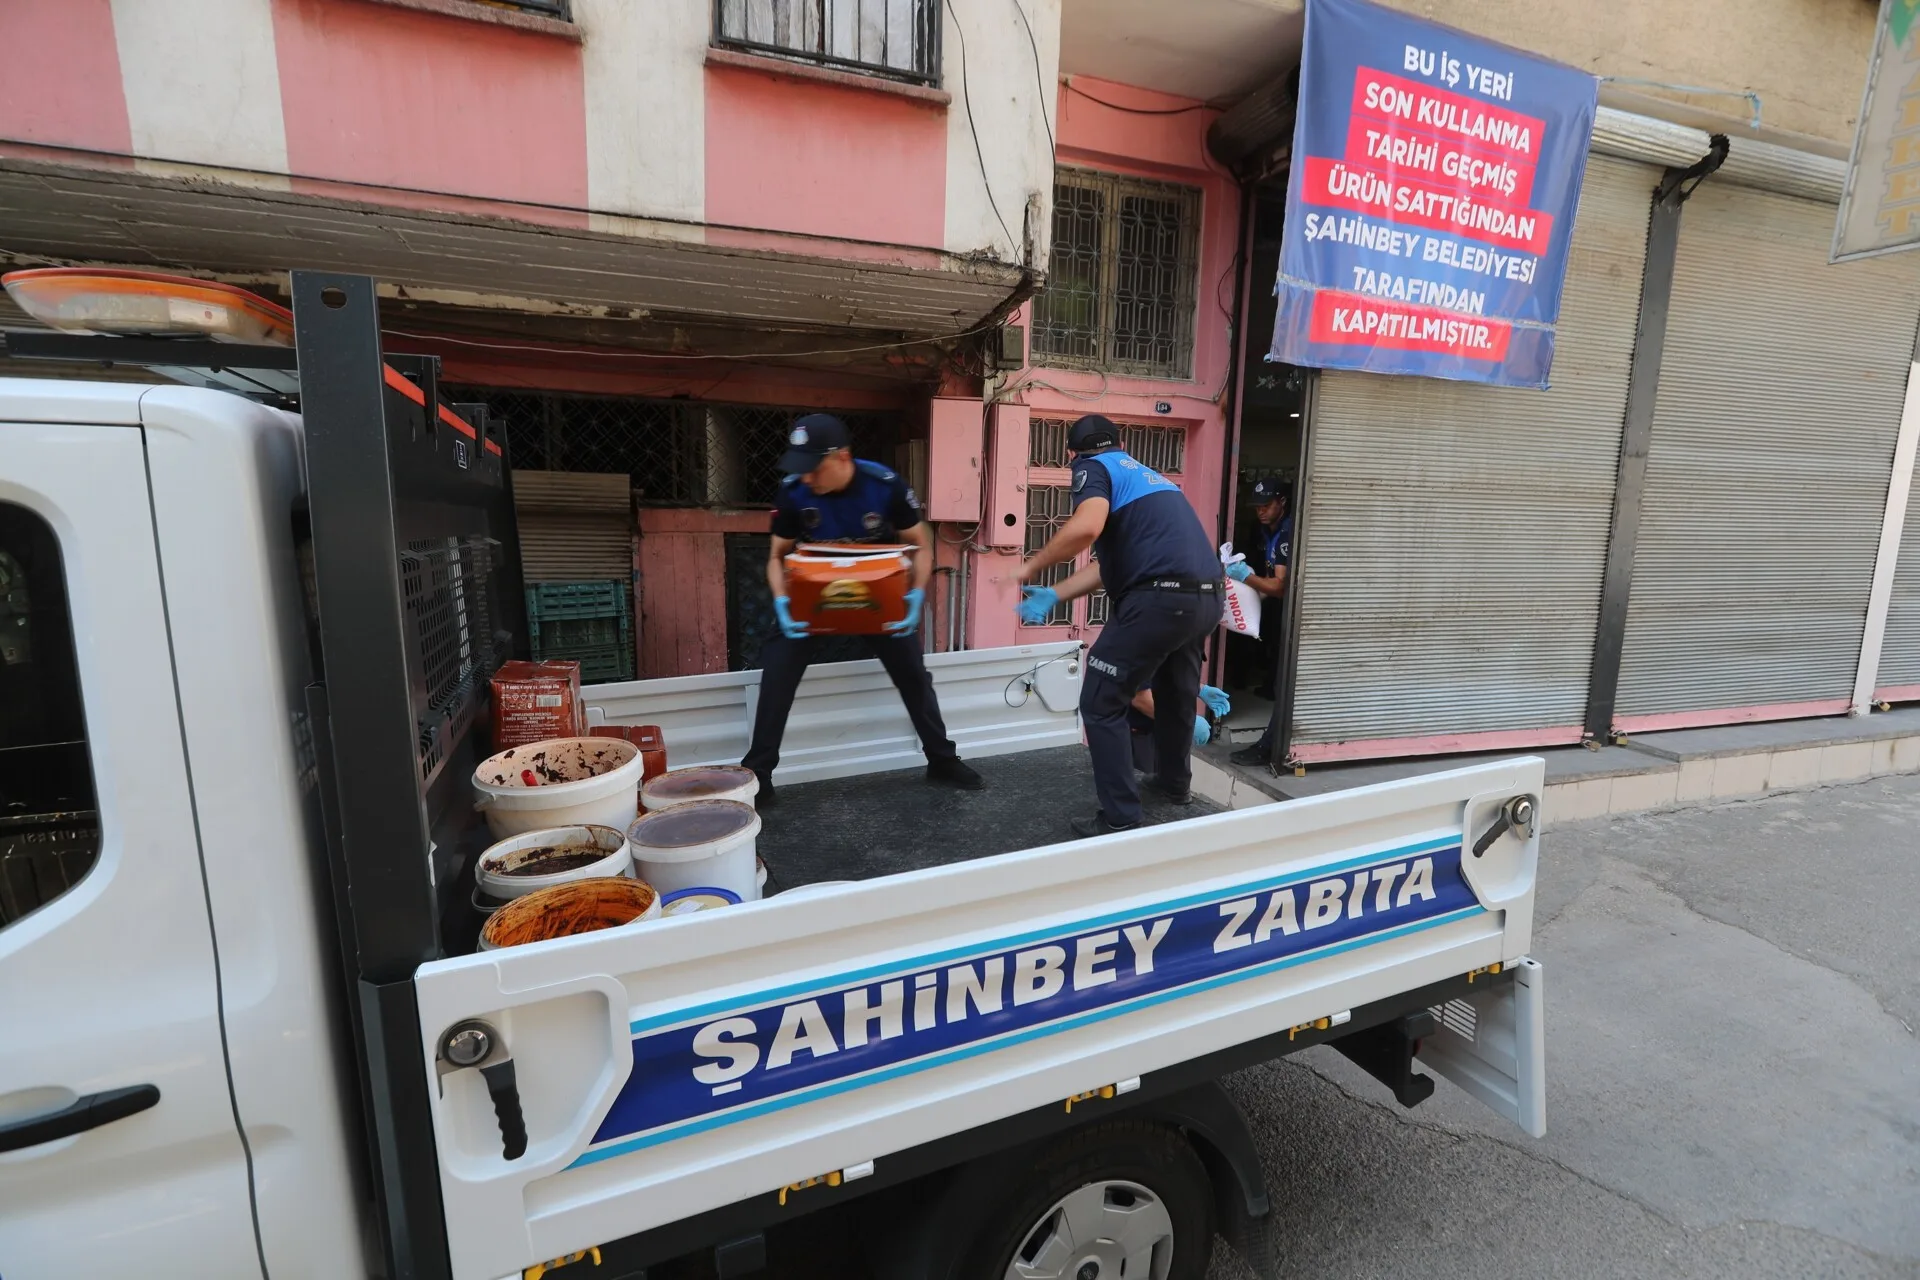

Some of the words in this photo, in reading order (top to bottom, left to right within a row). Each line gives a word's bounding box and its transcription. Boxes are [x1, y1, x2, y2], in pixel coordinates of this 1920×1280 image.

[1404, 44, 1435, 76] BU
[1440, 50, 1460, 88] İŞ
[1466, 63, 1514, 101] YERİ
[1364, 82, 1414, 119] SON
[1416, 96, 1531, 153] KULLANMA
[1365, 130, 1439, 173] TARİHİ
[1442, 150, 1517, 197] GEÇMİŞ
[1327, 164, 1392, 207] ÜRÜN
[1394, 186, 1536, 241] SATTIĞINDAN
[1304, 213, 1420, 256] ŞAHİNBEY
[1423, 237, 1537, 285] BELEDİYESİ
[1353, 266, 1485, 316] TARAFINDAN
[1332, 308, 1492, 349] KAPATILMIŞTIR.
[1213, 856, 1437, 954] ZABITA
